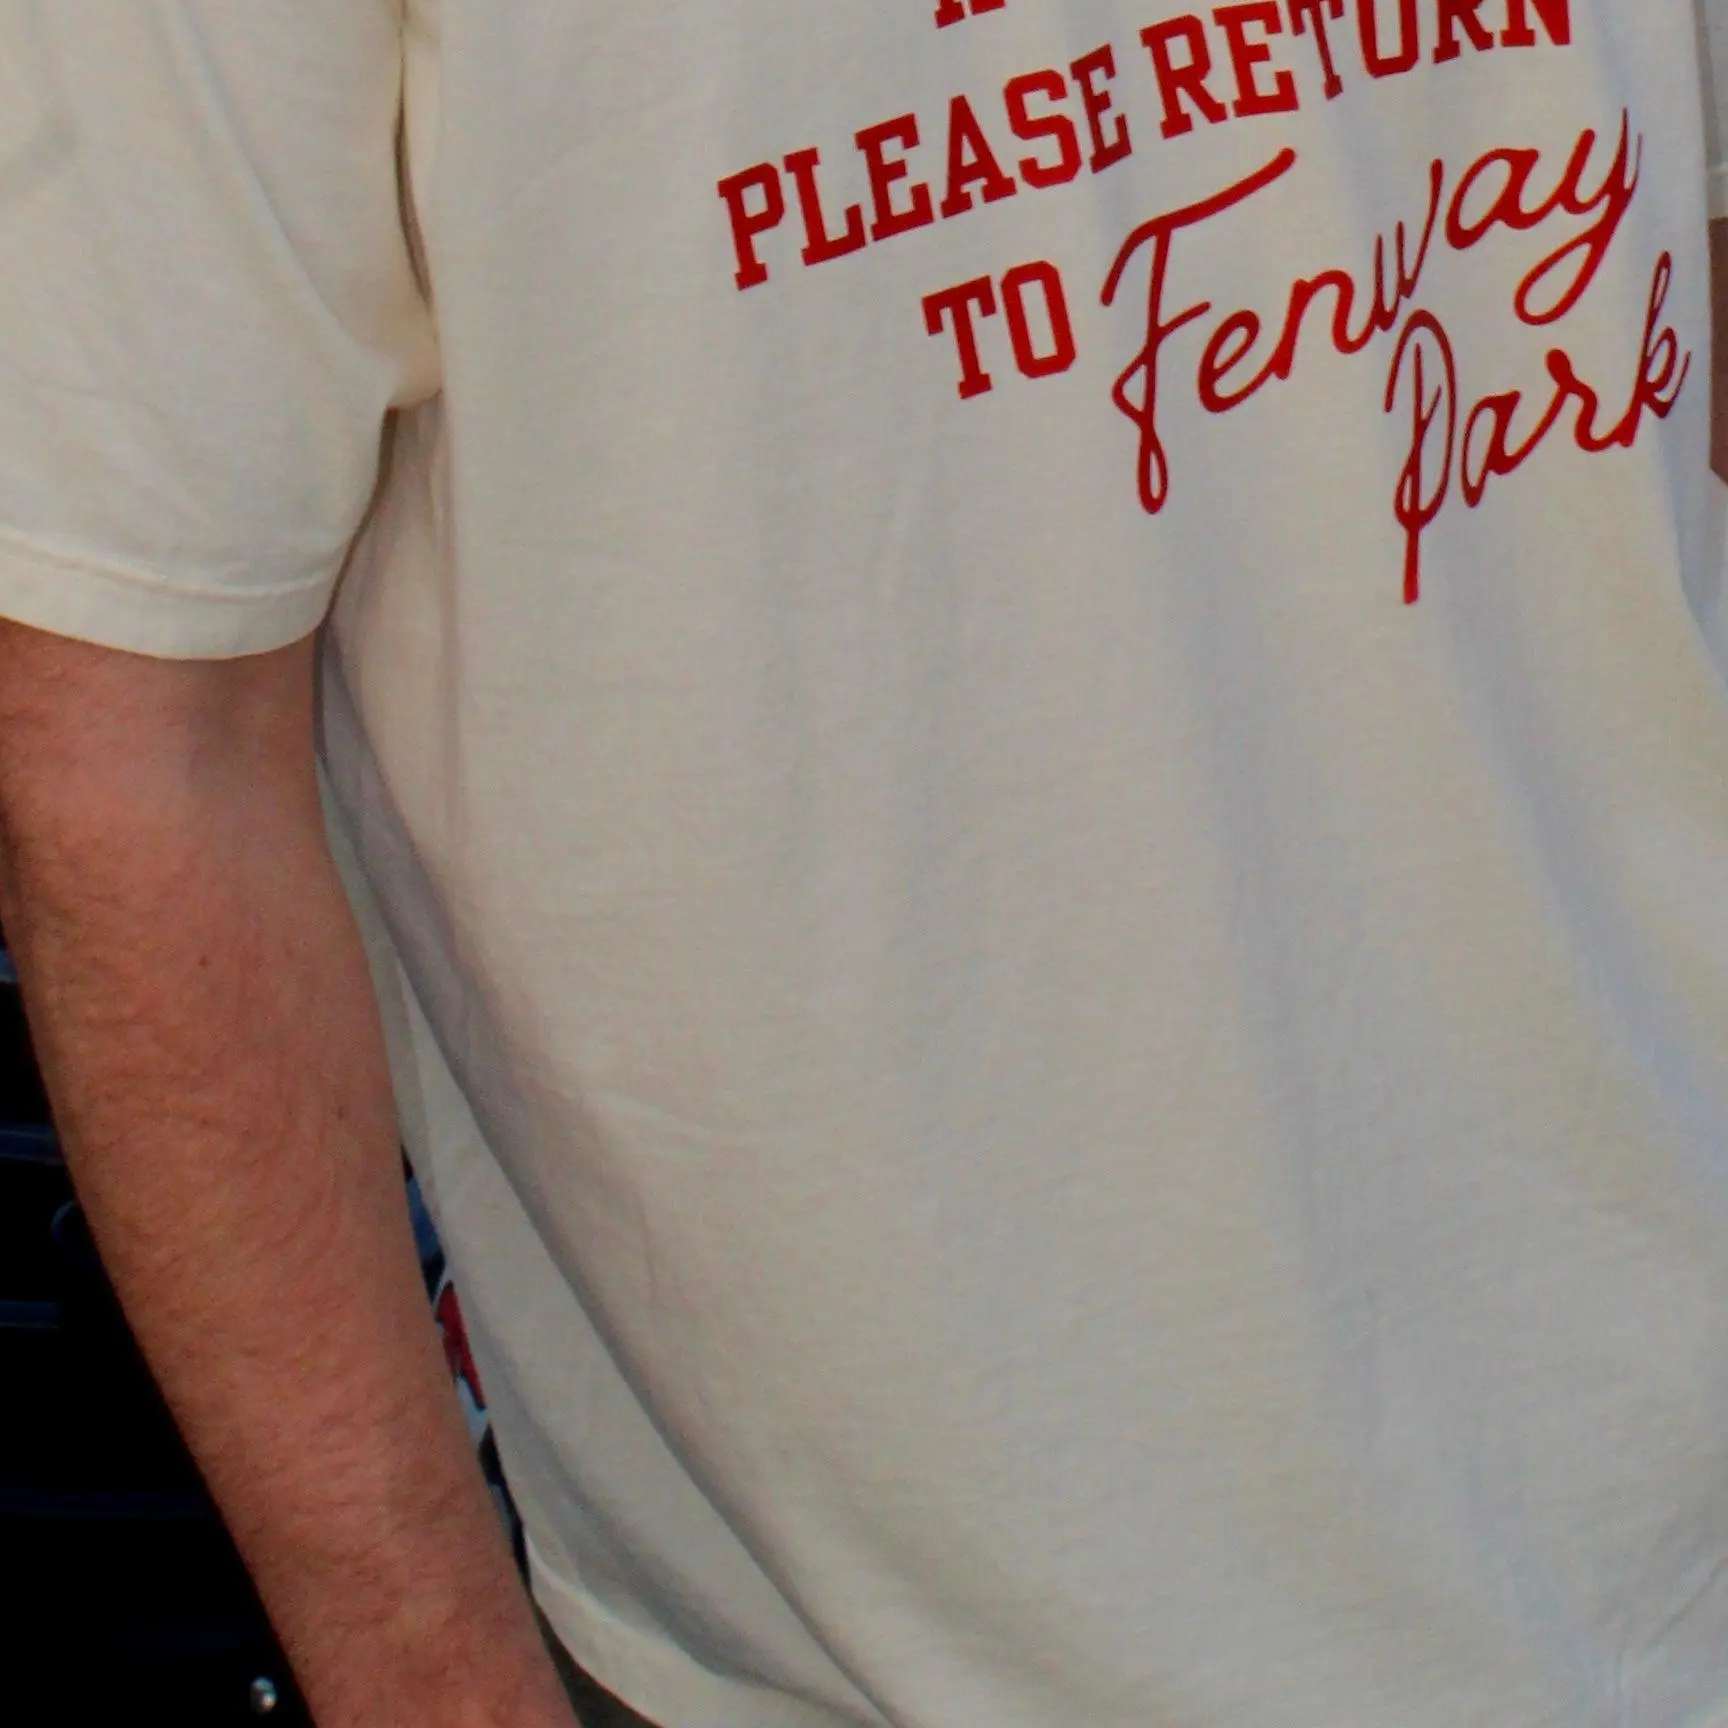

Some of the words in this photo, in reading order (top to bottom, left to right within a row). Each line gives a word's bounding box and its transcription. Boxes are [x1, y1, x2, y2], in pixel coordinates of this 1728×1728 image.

[716, 44, 1131, 290] PLEASE
[921, 260, 1077, 399] TO
[1099, 108, 1642, 512] Fenway
[1382, 250, 1691, 605] Park
